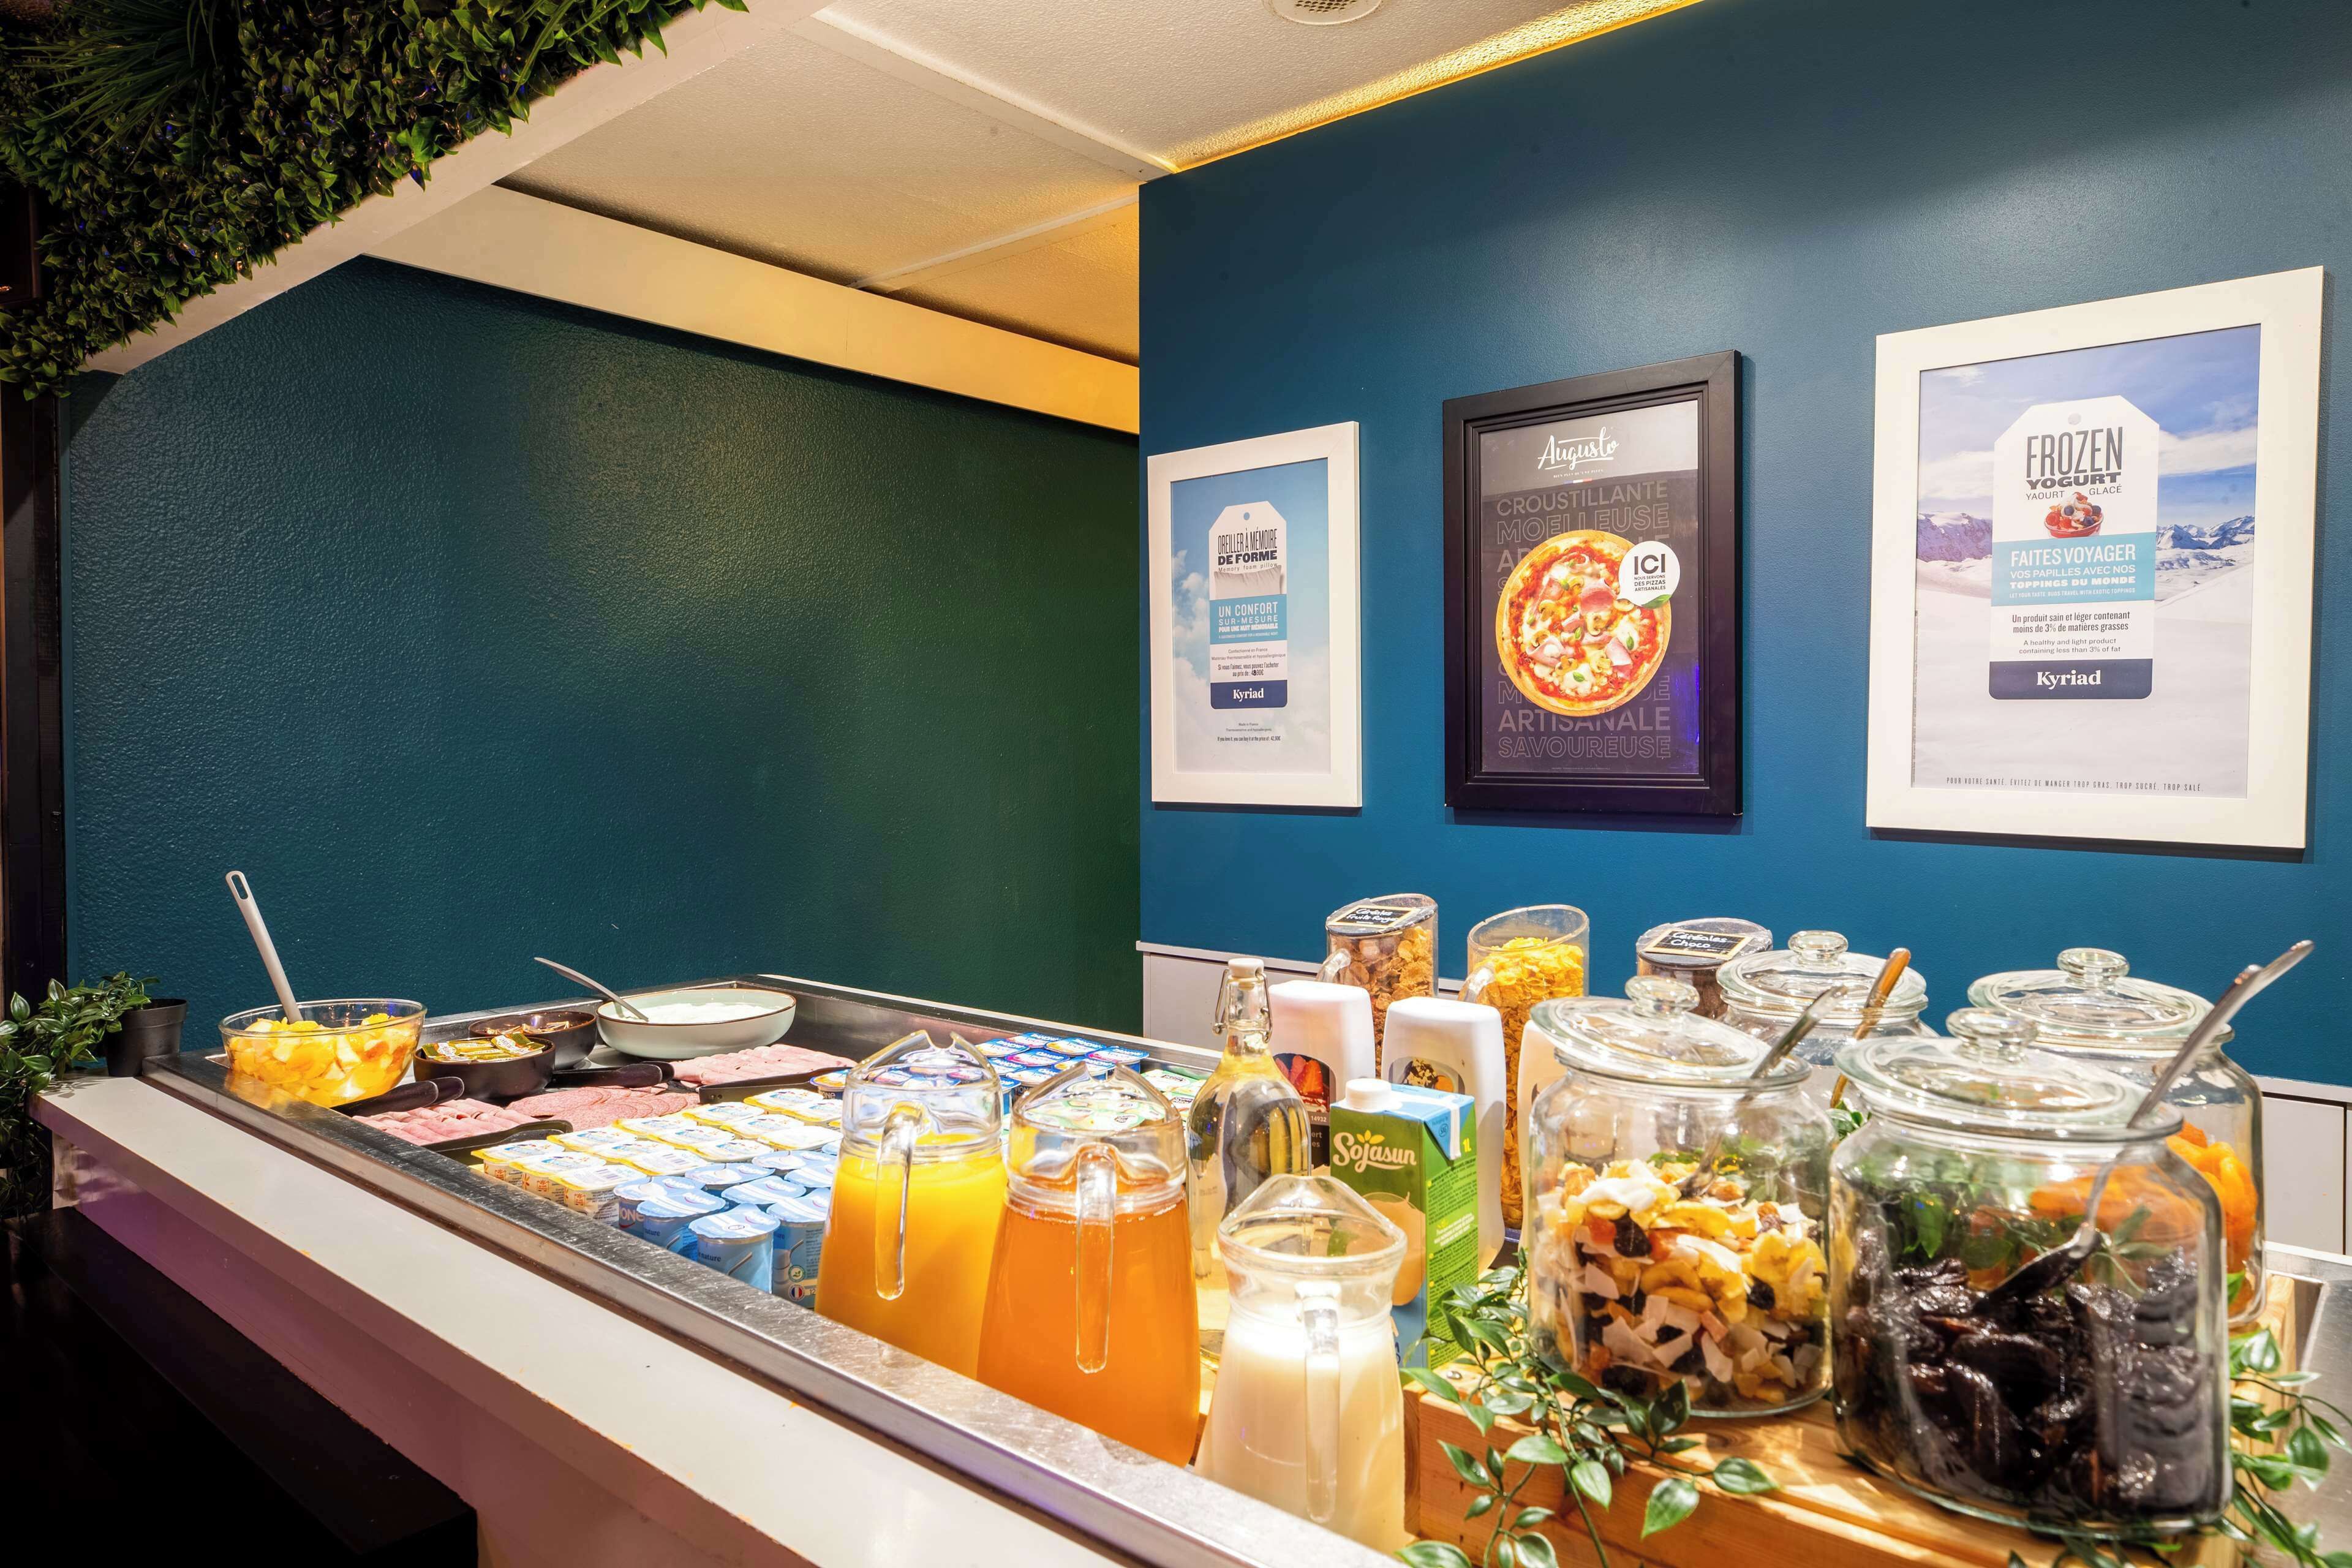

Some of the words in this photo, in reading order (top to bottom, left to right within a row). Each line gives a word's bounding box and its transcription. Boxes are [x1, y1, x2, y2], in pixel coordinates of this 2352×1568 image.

[1538, 426, 1619, 470] Augusto
[2026, 427, 2123, 478] FROZEN
[2026, 472, 2121, 490] YOGURT
[1497, 480, 1668, 516] CROUSTILLANTE
[2026, 491, 2065, 500] YAOURT
[2089, 484, 2122, 496] GLACÉ
[1218, 533, 1244, 554] OREILLER
[1250, 526, 1278, 551] MÉMOIRE
[1218, 555, 1233, 565] DE
[1235, 550, 1278, 564] FORME
[2011, 548, 2061, 567] FAITES
[2064, 544, 2136, 564] VOYAGER
[1634, 554, 1665, 575] ICI
[2010, 570, 2030, 579] VOS
[2033, 568, 2081, 578] PAPILLES
[2083, 566, 2111, 576] AVEC
[2113, 565, 2135, 573] NOS
[2010, 579, 2068, 589] TOPPINGS
[2092, 576, 2135, 585] MONDE
[1219, 606, 1231, 617] UN
[1235, 602, 1278, 616] CONFORT
[2023, 613, 2048, 624] produit
[2049, 613, 2064, 622] sain
[2075, 612, 2092, 622] léger
[2094, 611, 2130, 620] contenant
[1219, 615, 1278, 625] SUR-MESURE
[2013, 625, 2033, 633] moins
[2045, 624, 2056, 632] 3%
[2068, 622, 2098, 631] matières
[2101, 622, 2128, 633] grasses
[2037, 669, 2101, 690] Kyriad
[1233, 688, 1264, 702] Kyriad
[1498, 707, 1671, 732] ARTISANALE
[1498, 735, 1671, 758] SAVOUREUSE
[1670, 939, 1711, 948] Choco
[1333, 1132, 1417, 1173] Sojasun
[1463, 1137, 1472, 1152] 1L
